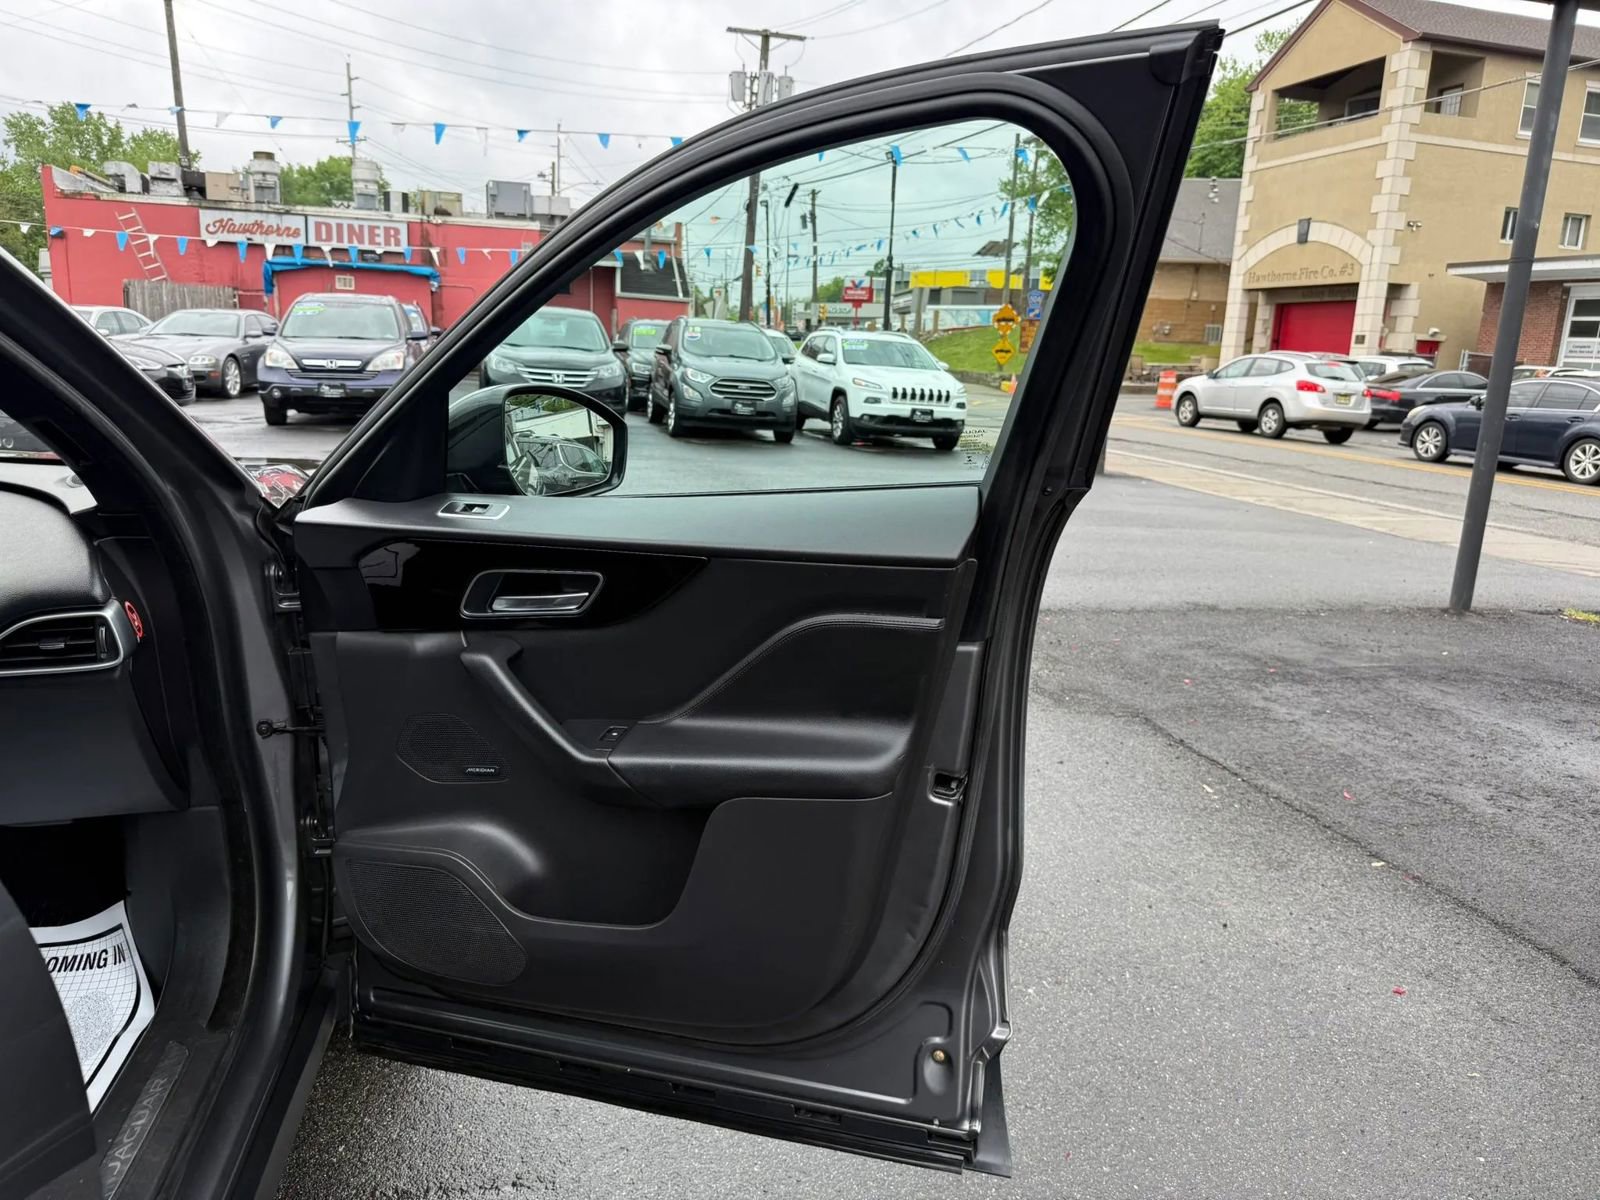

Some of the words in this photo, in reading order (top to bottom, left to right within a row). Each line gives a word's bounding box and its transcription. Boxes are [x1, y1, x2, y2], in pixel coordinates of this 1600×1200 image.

[205, 217, 302, 239] Hawthorne
[314, 221, 401, 247] DINER
[1248, 270, 1298, 284] Hawthorne
[1299, 267, 1319, 281] Fire
[1321, 265, 1337, 279] Co.
[1339, 262, 1354, 277] #3
[47, 948, 108, 974] OMING
[113, 943, 126, 965] IN
[107, 1078, 168, 1176] JAGUAR
